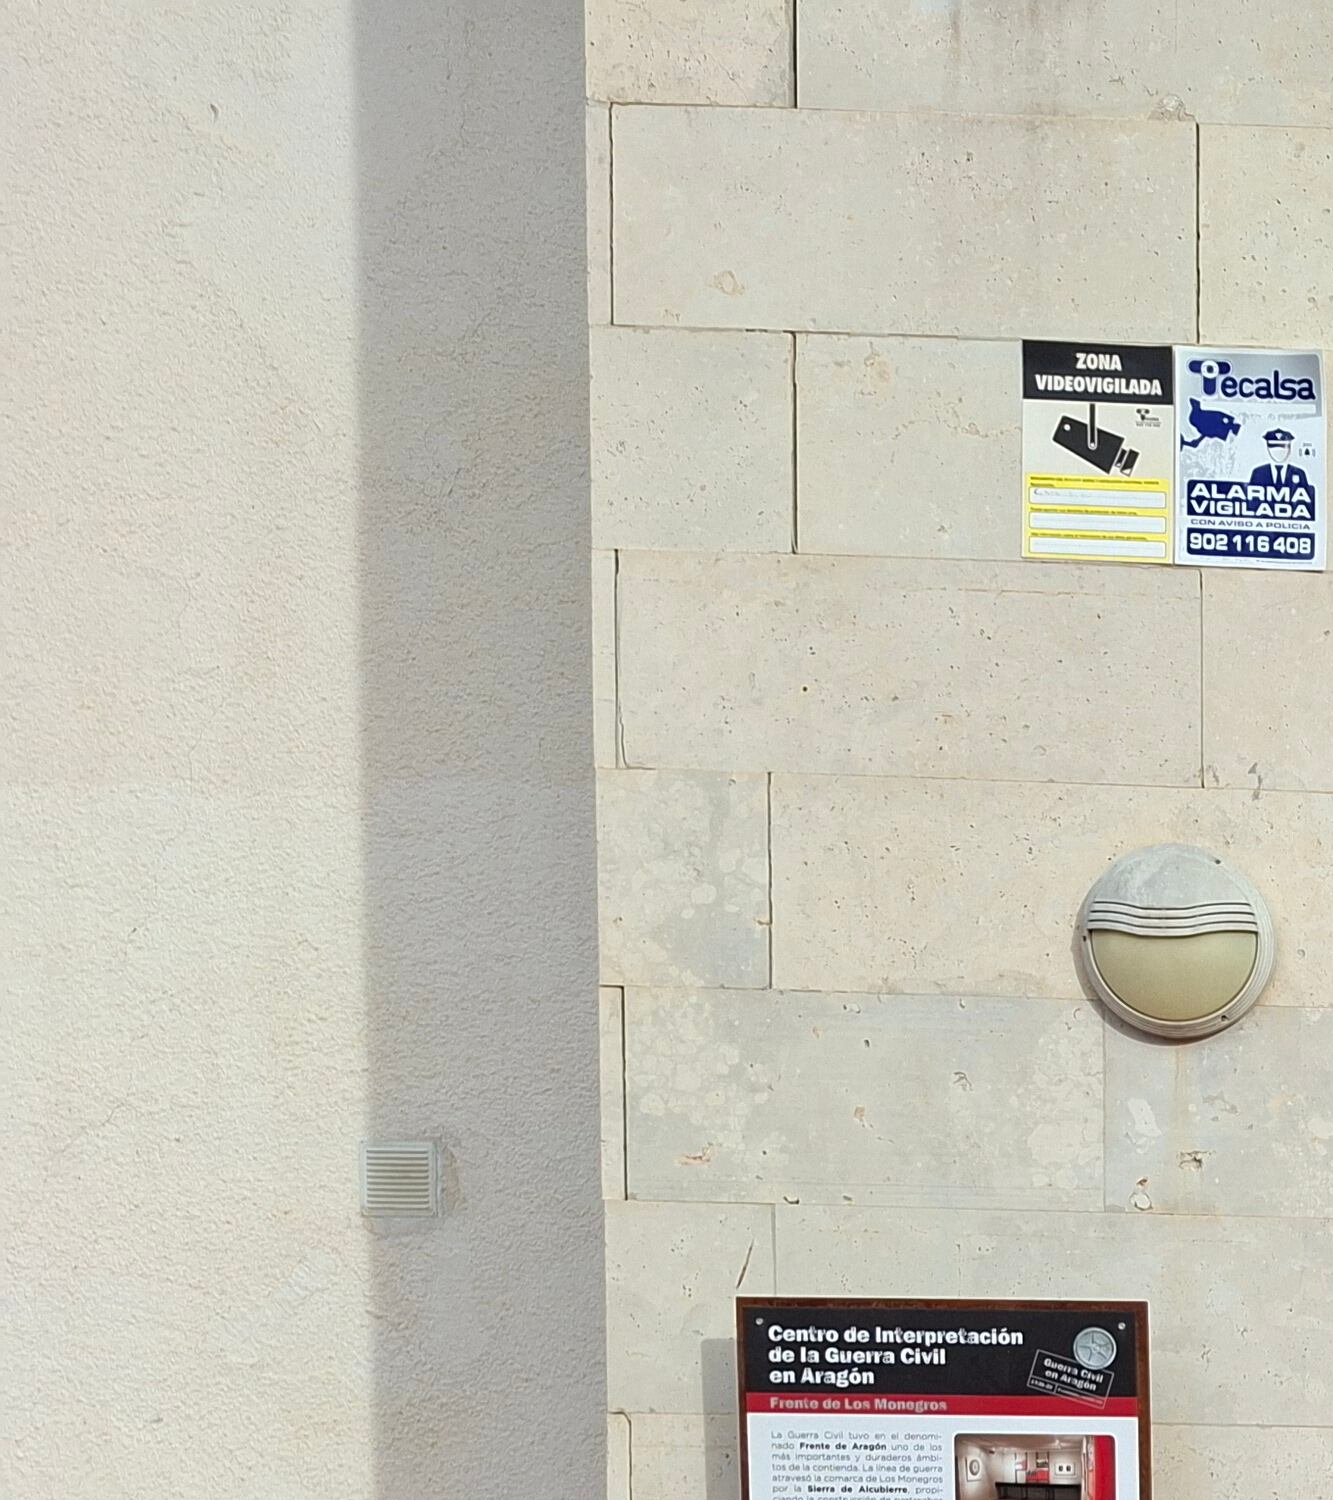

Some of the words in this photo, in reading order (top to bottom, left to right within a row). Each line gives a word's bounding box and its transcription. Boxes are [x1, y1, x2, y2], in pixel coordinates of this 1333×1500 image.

[1075, 353, 1122, 371] ZONA
[1035, 374, 1162, 395] VIDEOVIGILADA
[1189, 360, 1316, 400] Tecalsa
[1190, 483, 1311, 502] ALARMA
[1190, 500, 1311, 518] VIGILADA
[1266, 522, 1310, 530] POLICIA
[1190, 532, 1228, 551] 902
[1233, 535, 1269, 552] 116
[1273, 537, 1311, 554] 408
[768, 1326, 839, 1342] Centro
[844, 1326, 870, 1343] de
[875, 1327, 1023, 1347] Interpretación
[768, 1347, 795, 1363] de
[800, 1347, 820, 1363] la
[825, 1348, 895, 1364] Guerra
[900, 1348, 946, 1364] Civil
[769, 1372, 795, 1384] en
[801, 1367, 875, 1387] Aragón
[1044, 1358, 1078, 1375] Guerra
[1081, 1369, 1103, 1383] Civil
[1045, 1370, 1058, 1380] en
[1060, 1374, 1097, 1391] Aragón
[770, 1397, 819, 1409] Frente
[822, 1398, 841, 1409] de
[844, 1398, 871, 1409] Los
[874, 1399, 947, 1413] Monegros
[771, 1431, 783, 1439] La
[787, 1431, 819, 1439] Guerra
[824, 1431, 844, 1439] Civil
[848, 1432, 870, 1440] tuvo
[891, 1432, 899, 1440] el
[904, 1432, 942, 1440] denomi-
[771, 1442, 795, 1450] nado
[799, 1442, 831, 1450] Frente
[835, 1442, 847, 1450] de
[852, 1442, 887, 1452] Aragón
[913, 1443, 925, 1451] de
[929, 1443, 942, 1451] los
[772, 1453, 791, 1461] más
[795, 1453, 851, 1462] importantes
[855, 1455, 861, 1463] y
[865, 1453, 912, 1461] duraderos
[916, 1453, 942, 1461] ámbi-
[772, 1463, 786, 1471] tos
[788, 1463, 800, 1471] de
[802, 1463, 810, 1471] la
[862, 1464, 874, 1472] La
[876, 1464, 897, 1472] línea
[899, 1464, 911, 1472] de
[913, 1466, 943, 1474] guerra
[772, 1474, 812, 1482] atravesó
[814, 1474, 822, 1482] la
[865, 1475, 878, 1483] de
[879, 1475, 896, 1483] Los
[897, 1475, 943, 1484] Monegros
[794, 1485, 802, 1493] la
[807, 1485, 836, 1493] Sierra
[841, 1485, 853, 1493] de
[915, 1486, 943, 1495] propi-
